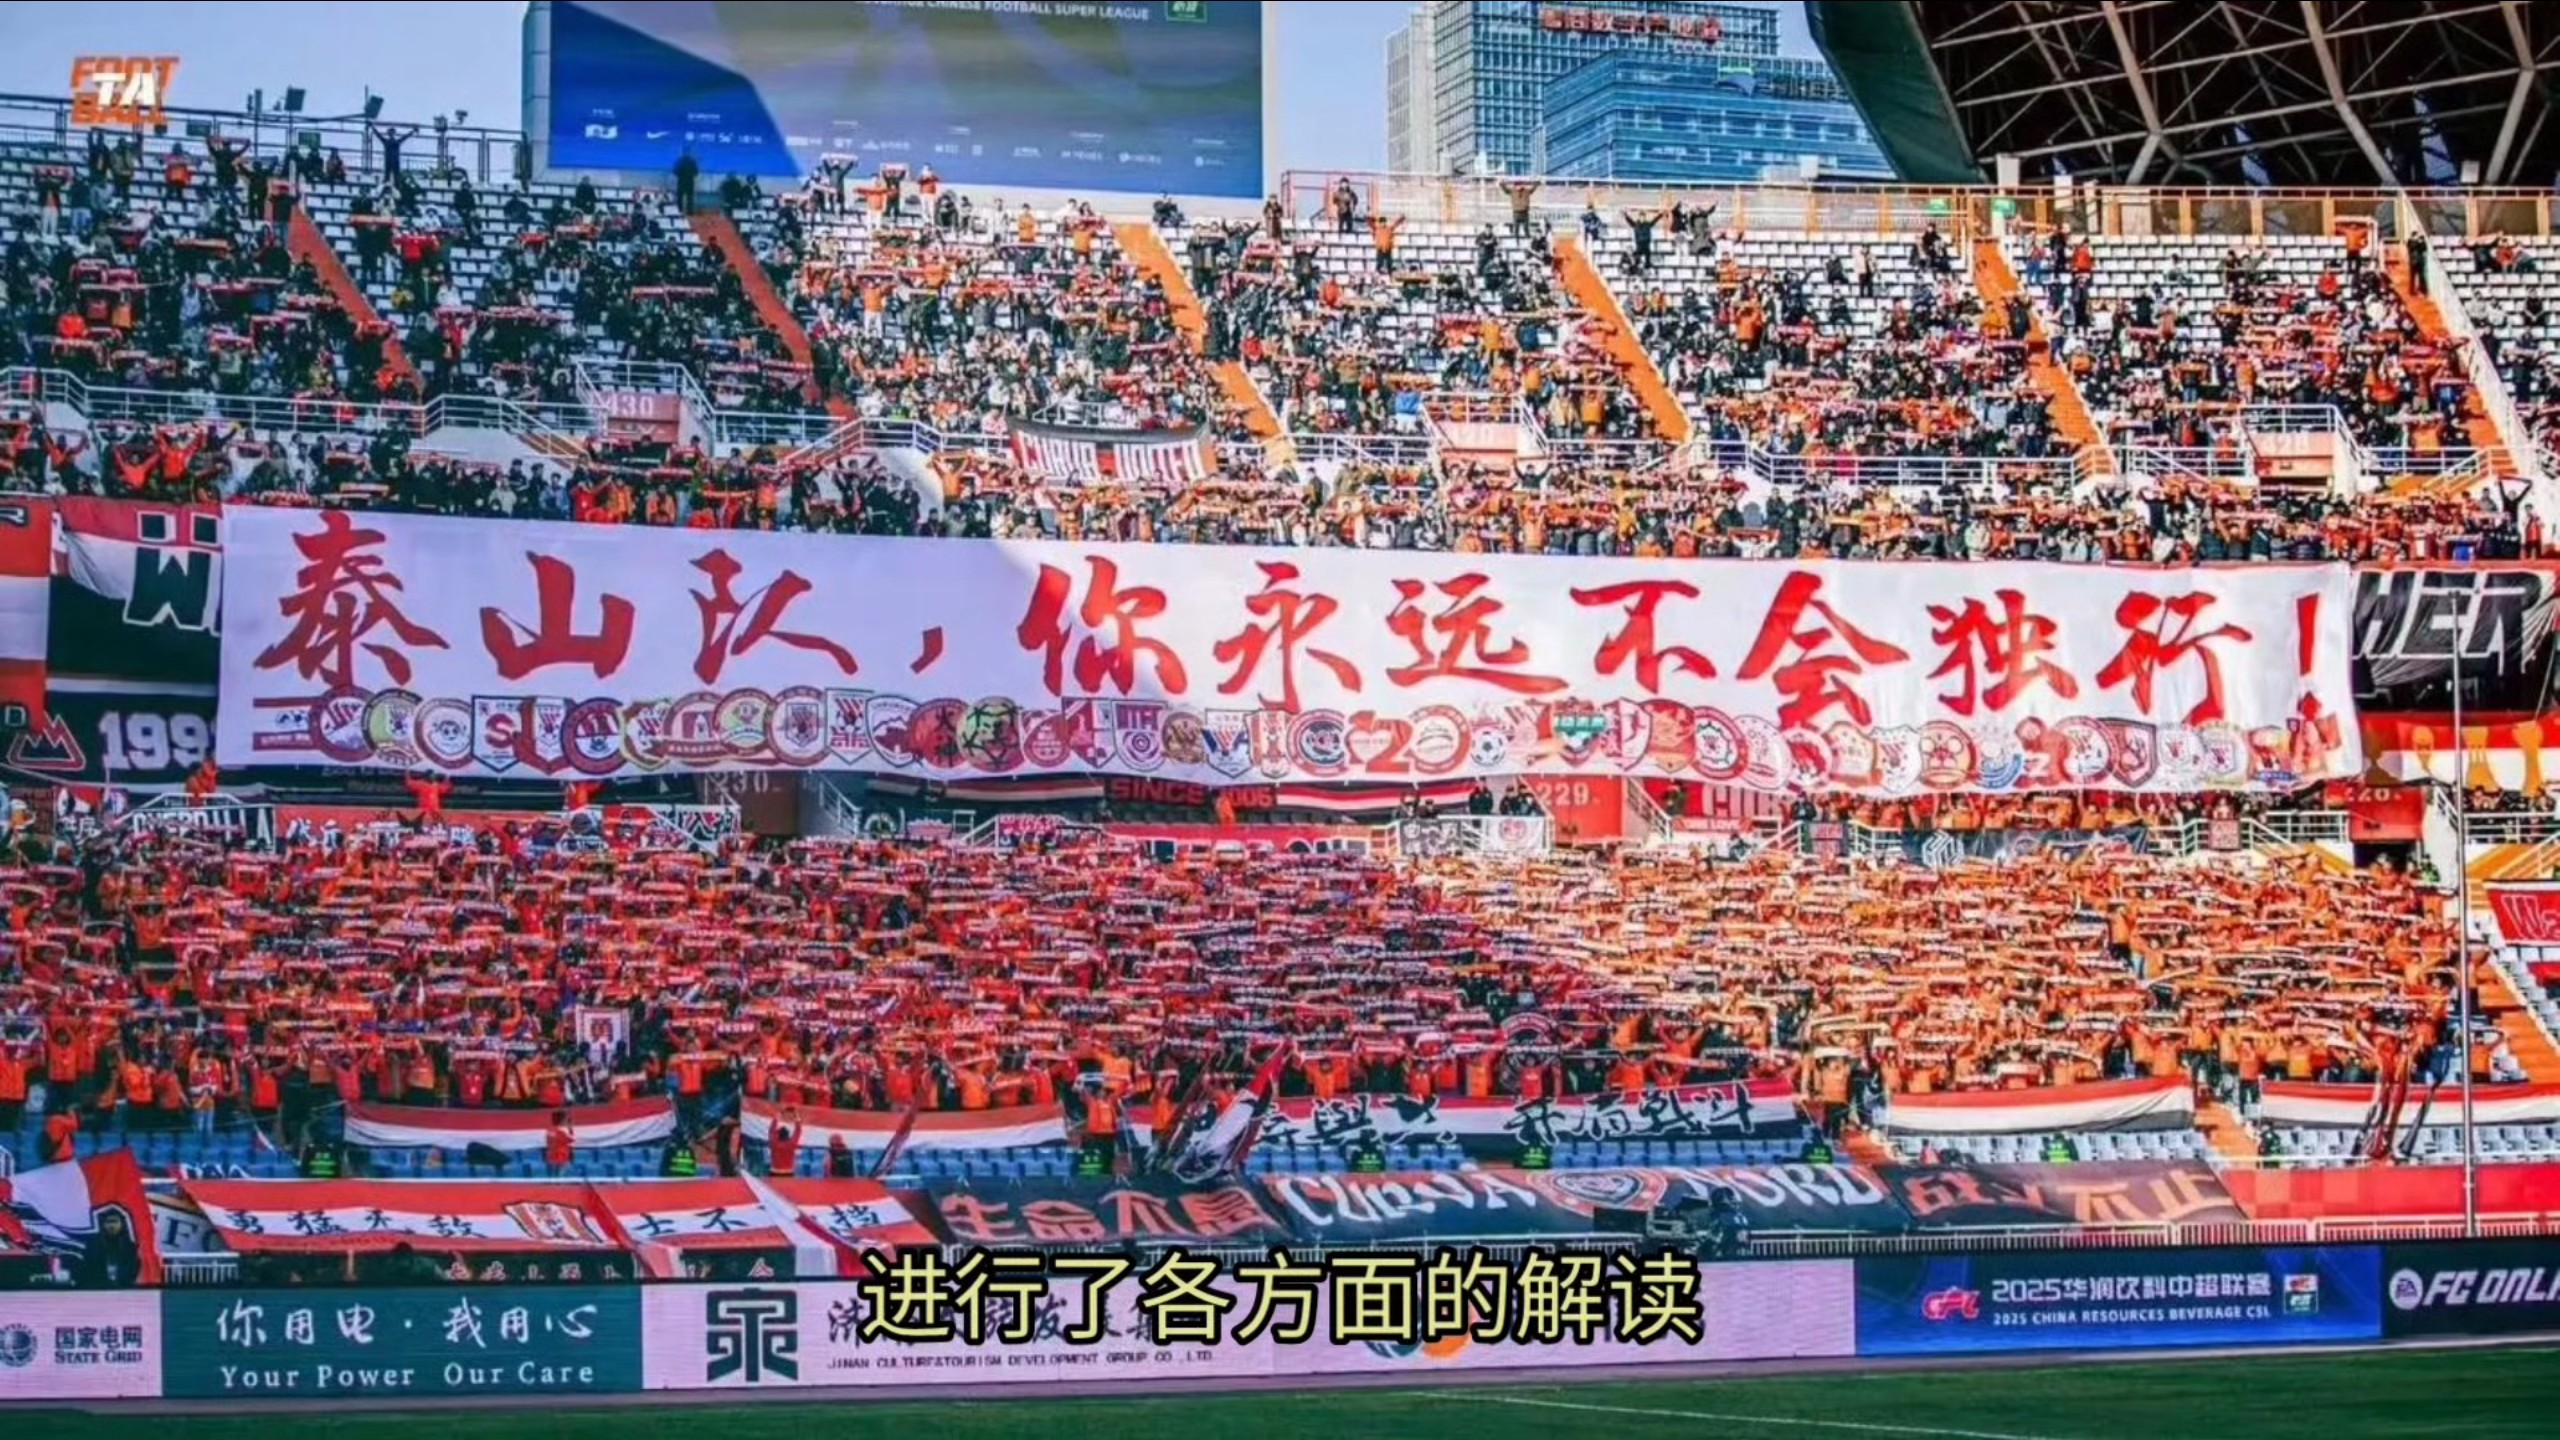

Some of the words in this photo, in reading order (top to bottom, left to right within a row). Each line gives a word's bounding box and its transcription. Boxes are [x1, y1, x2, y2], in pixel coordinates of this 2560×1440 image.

[984, 2, 1053, 15] FOOTBALL
[1055, 5, 1096, 18] SUPER
[1099, 7, 1150, 20] LEAGUE
[98, 711, 222, 770] 199
[1112, 778, 1205, 807] SINCE
[1276, 1172, 1537, 1226] CURVA
[1991, 1271, 2272, 1302] 2025华润饮料中超联赛
[2423, 1270, 2479, 1306] FC
[216, 1296, 598, 1349] 你用电·我用心
[1993, 1312, 2028, 1326] 2025
[2032, 1310, 2078, 1324] CHINA
[2082, 1307, 2165, 1323] RESOURCES
[2168, 1305, 2242, 1321] BEVERAGE
[2246, 1304, 2272, 1319] CSL
[54, 1325, 143, 1349] 国家电网
[54, 1351, 100, 1365] STATE
[104, 1350, 143, 1363] GRID
[827, 1356, 870, 1369] JINAN
[1008, 1352, 1098, 1366] DEVELOPMENT
[1106, 1351, 1148, 1364] GROUP
[219, 1366, 299, 1389] Your
[317, 1364, 414, 1388] Power
[443, 1362, 504, 1387] Our
[518, 1361, 595, 1385] Care
